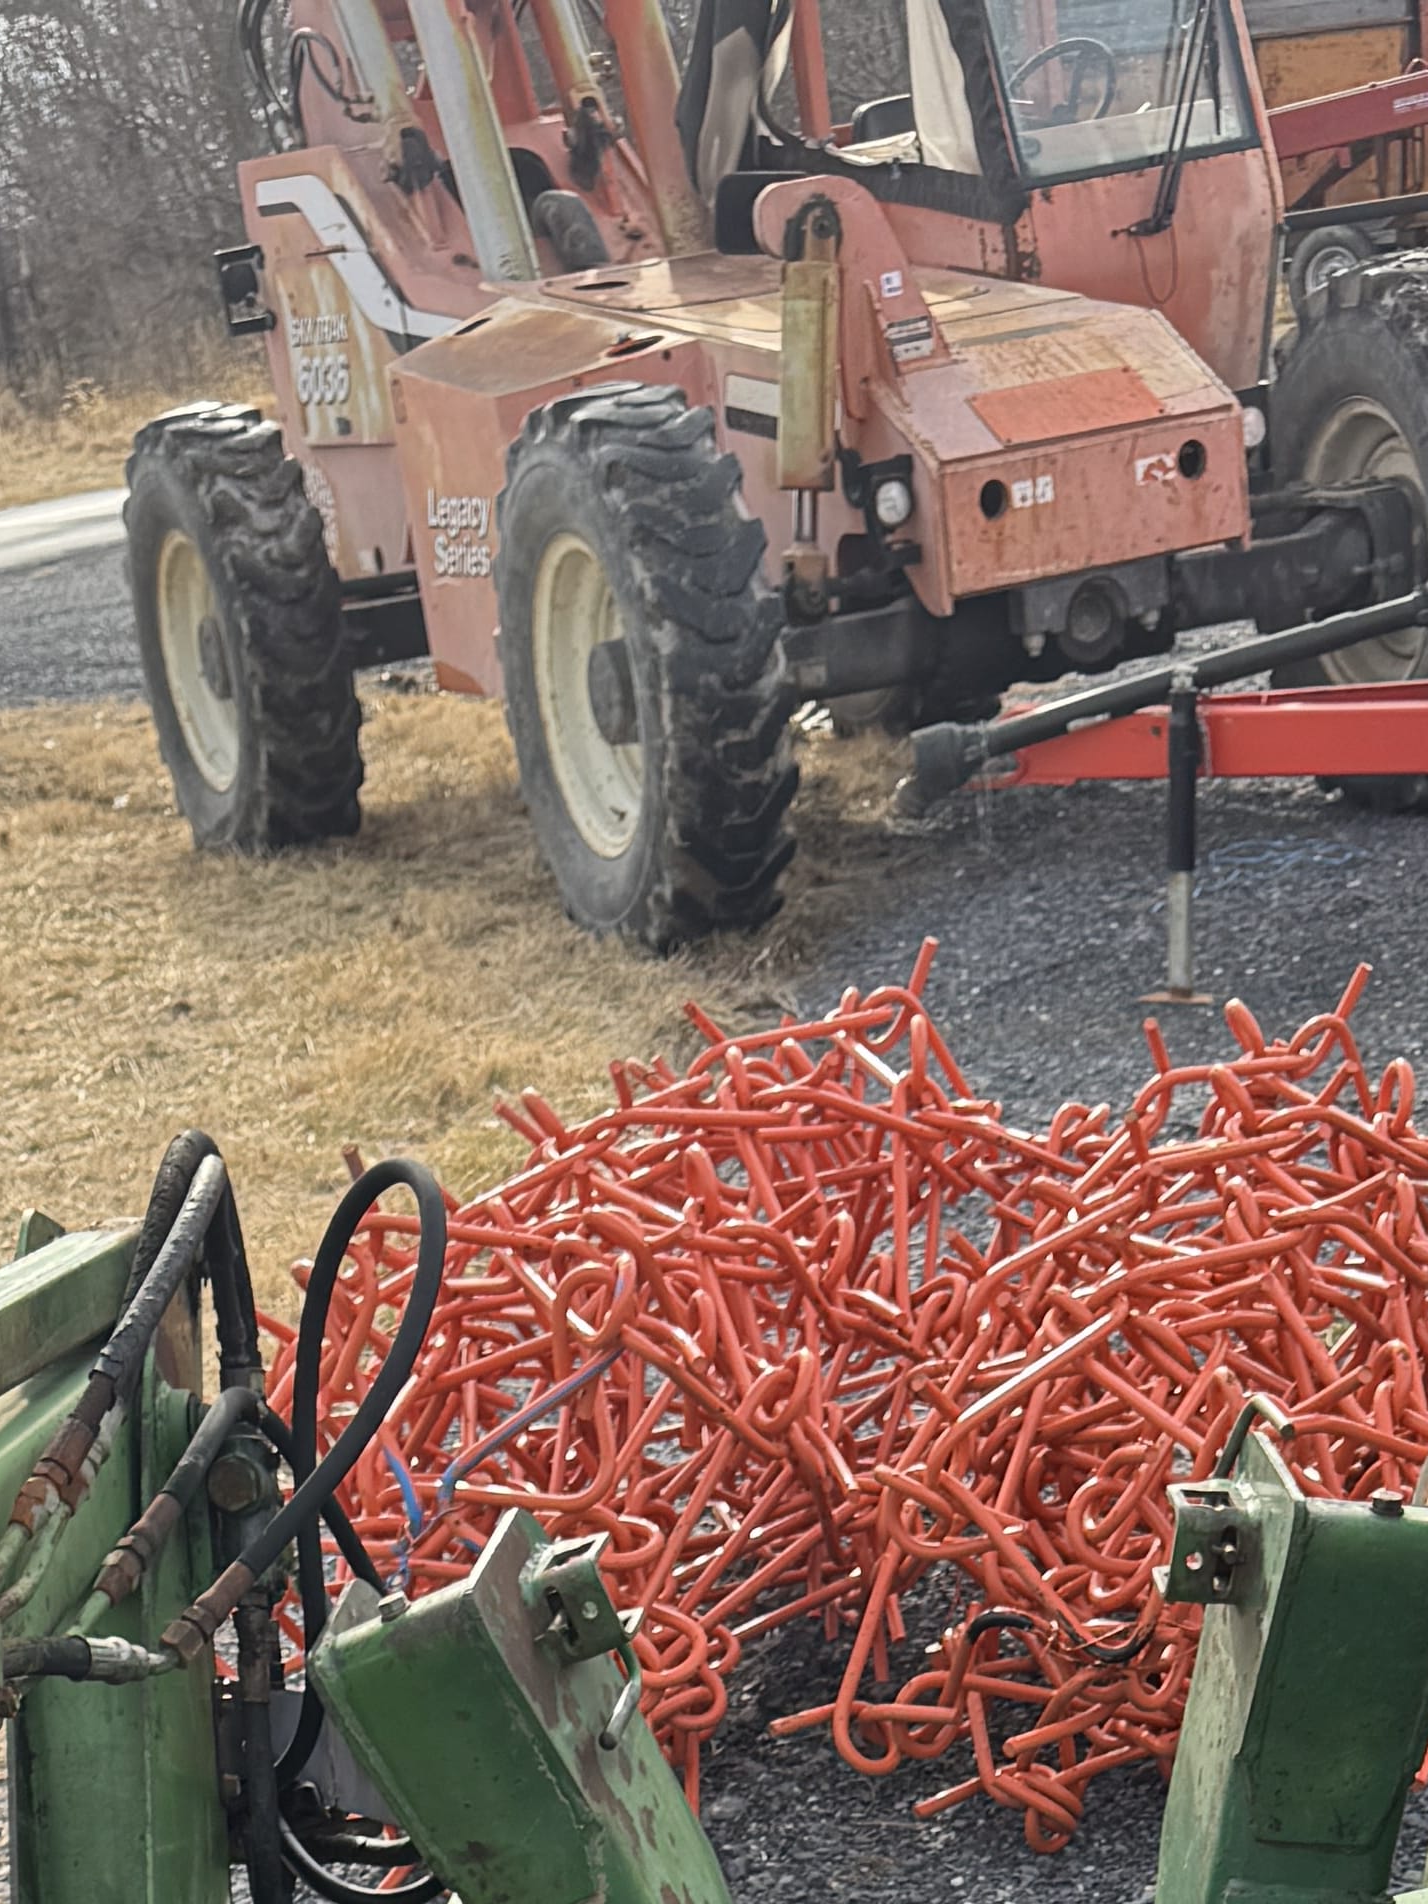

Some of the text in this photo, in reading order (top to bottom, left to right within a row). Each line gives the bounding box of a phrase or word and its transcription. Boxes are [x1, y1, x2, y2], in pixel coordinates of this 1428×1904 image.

[298, 354, 350, 404] 6036
[427, 487, 491, 538] Legacy
[434, 535, 492, 578] Series
